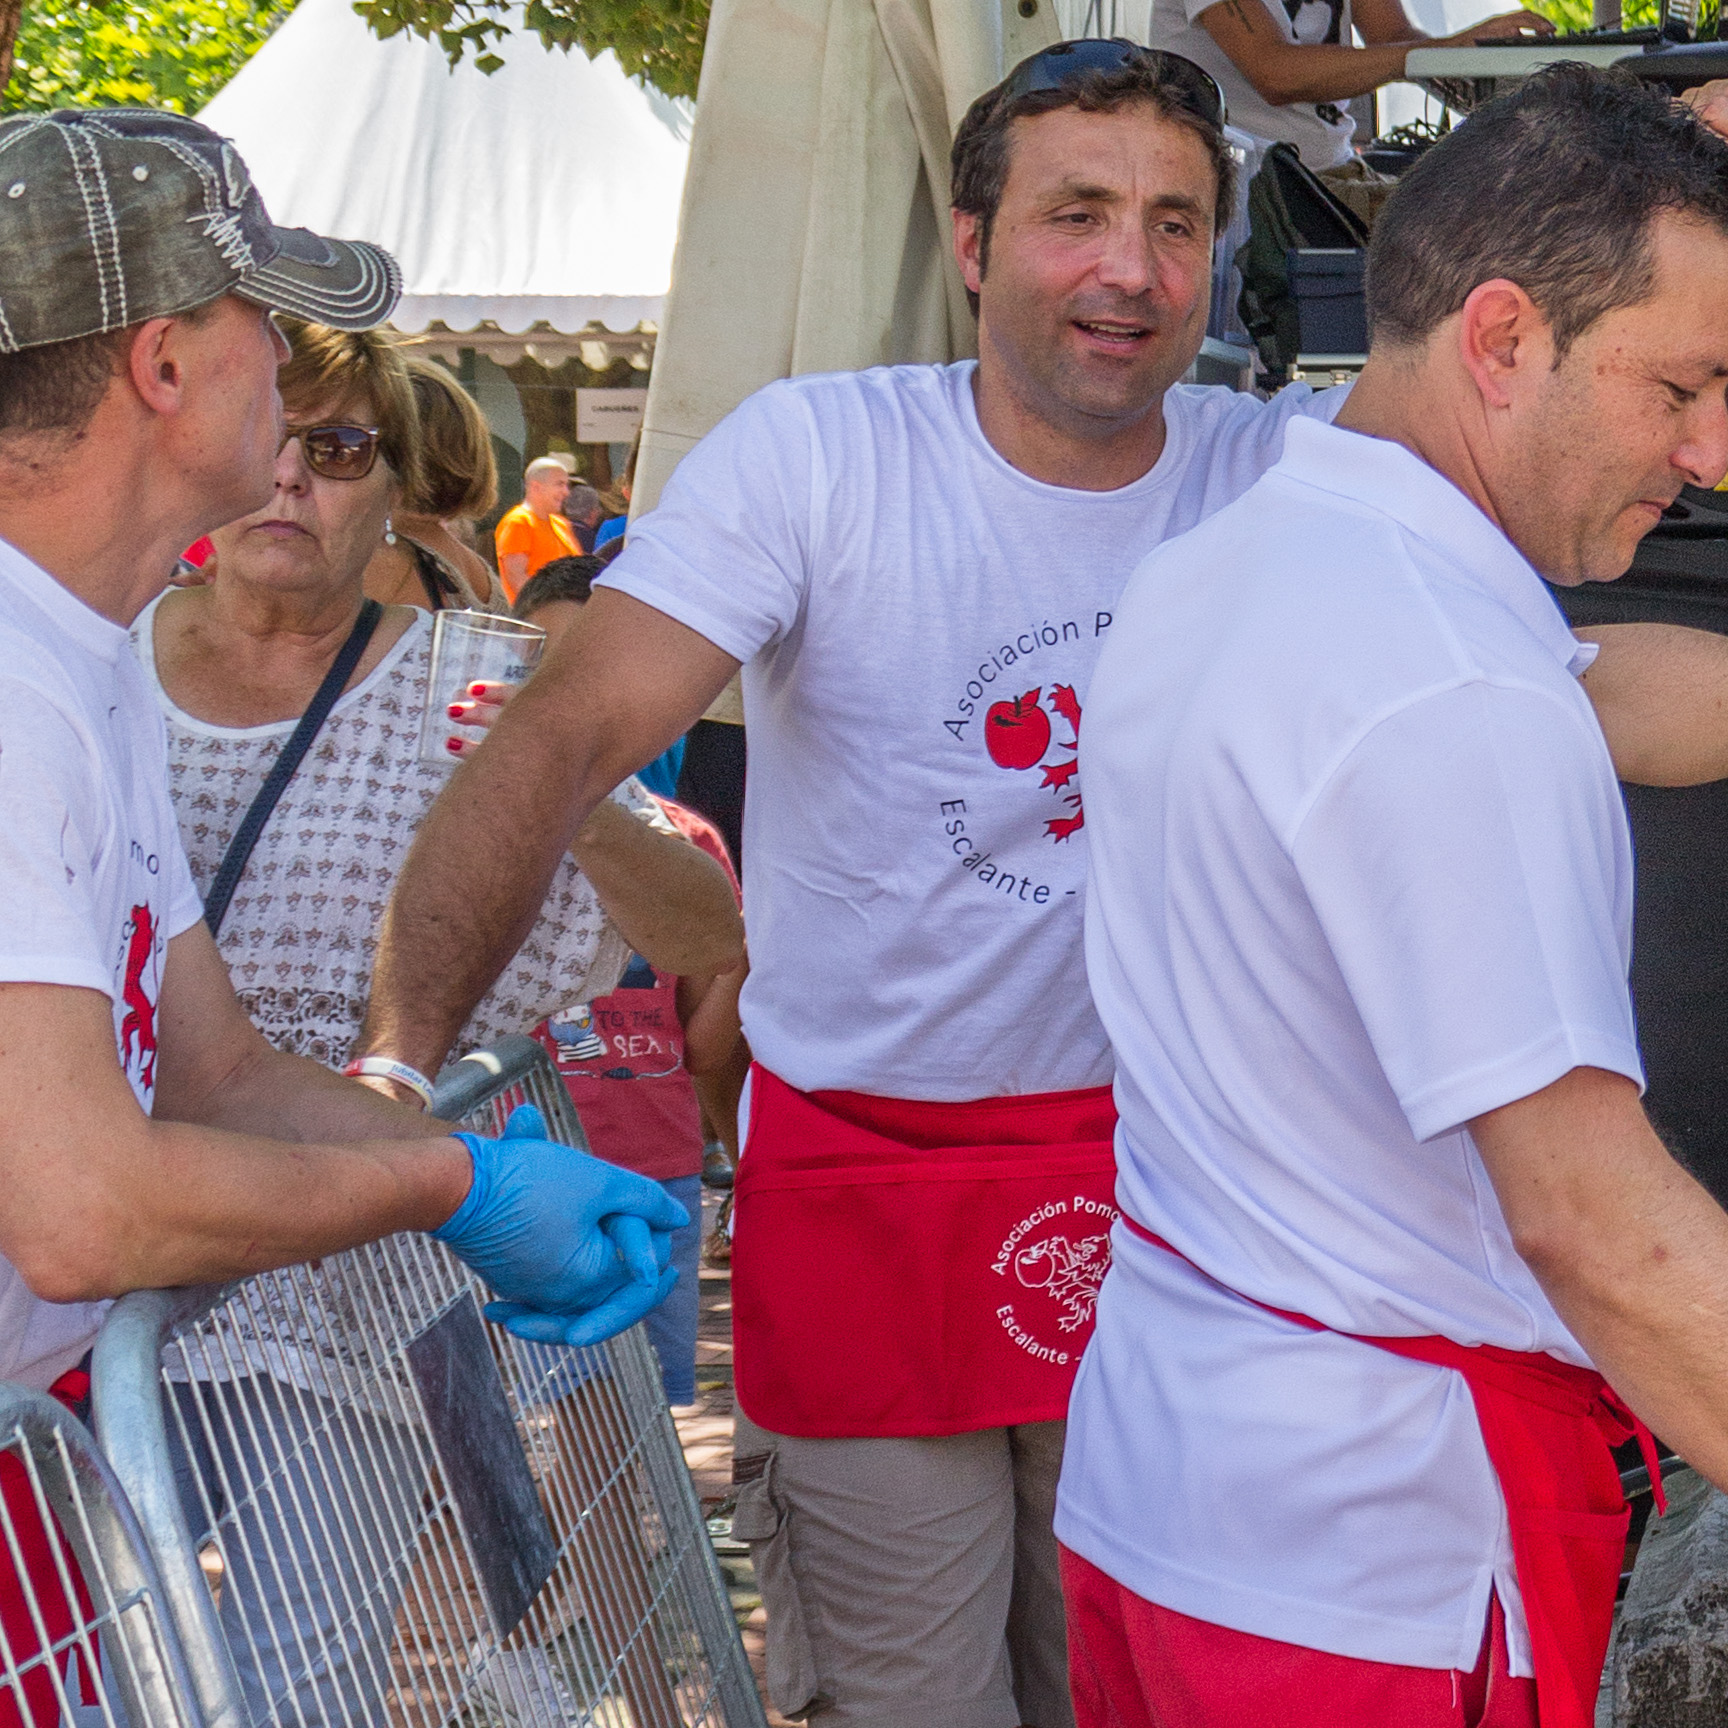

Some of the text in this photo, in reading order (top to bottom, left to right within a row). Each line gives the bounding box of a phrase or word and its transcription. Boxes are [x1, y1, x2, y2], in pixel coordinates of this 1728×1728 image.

[943, 619, 1080, 742] Asociación
[940, 799, 1050, 904] Escalante
[597, 1007, 663, 1029] TO THE
[613, 1034, 662, 1058] SEA
[990, 1201, 1067, 1276] Asociación
[996, 1304, 1069, 1364] Escalante
